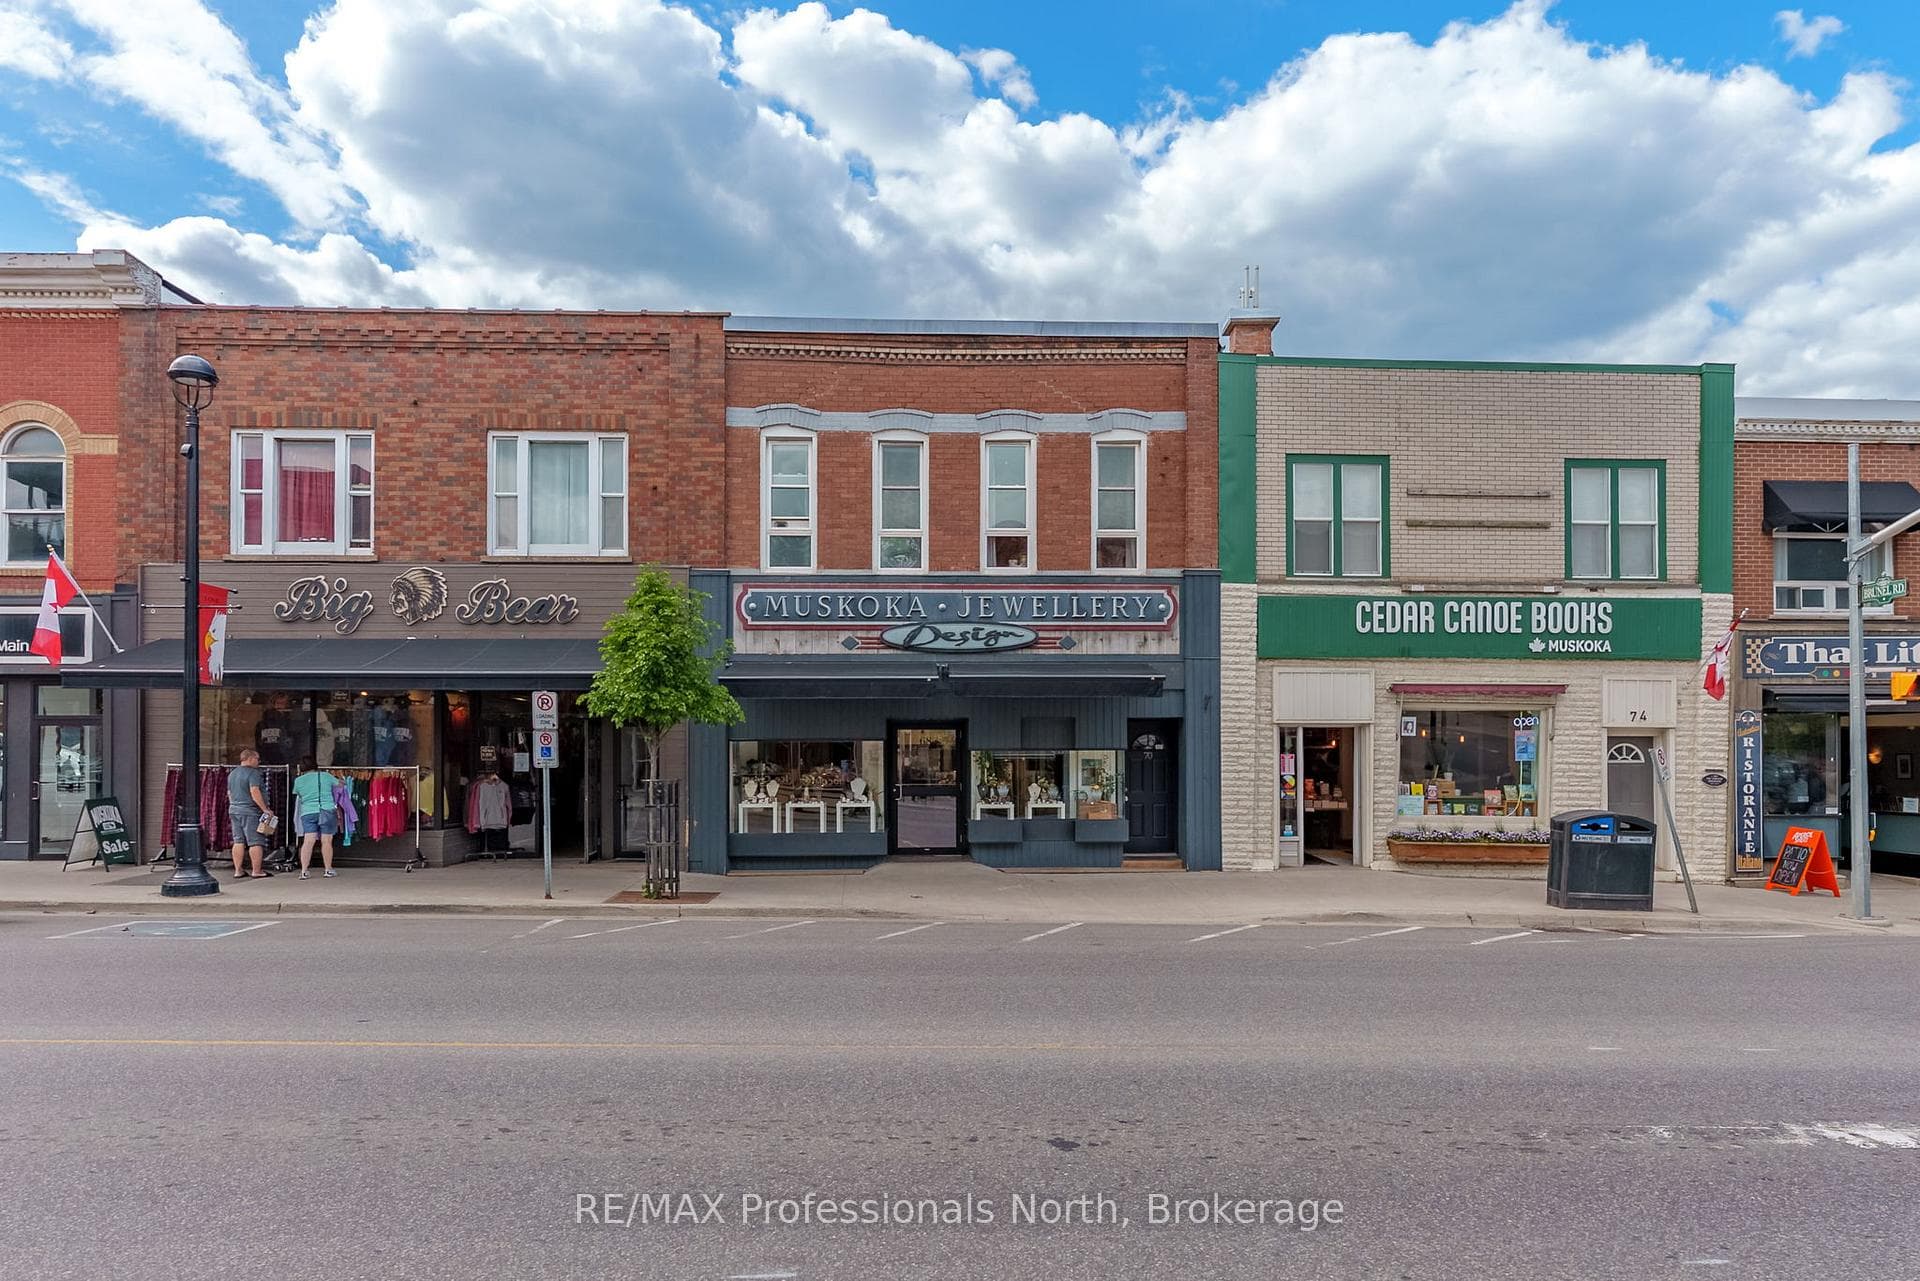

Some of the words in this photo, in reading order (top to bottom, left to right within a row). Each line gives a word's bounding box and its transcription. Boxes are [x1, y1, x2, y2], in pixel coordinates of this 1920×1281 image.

[273, 575, 375, 635] Big
[455, 578, 580, 625] Bear
[763, 595, 928, 618] MUSKOKA
[957, 596, 1152, 618] JEWELLERY
[1356, 601, 1435, 634] CEDAR
[1444, 601, 1523, 634] CANOE
[1531, 601, 1613, 634] BOOKS
[903, 621, 1024, 648] Design
[1548, 640, 1612, 652] MUSKOKA
[1779, 641, 1868, 664] Tha
[1513, 716, 1539, 730] open
[1630, 710, 1647, 722] 74
[1143, 751, 1153, 760] 70
[1743, 737, 1756, 853] RISTORANTE
[102, 838, 130, 854] Sale
